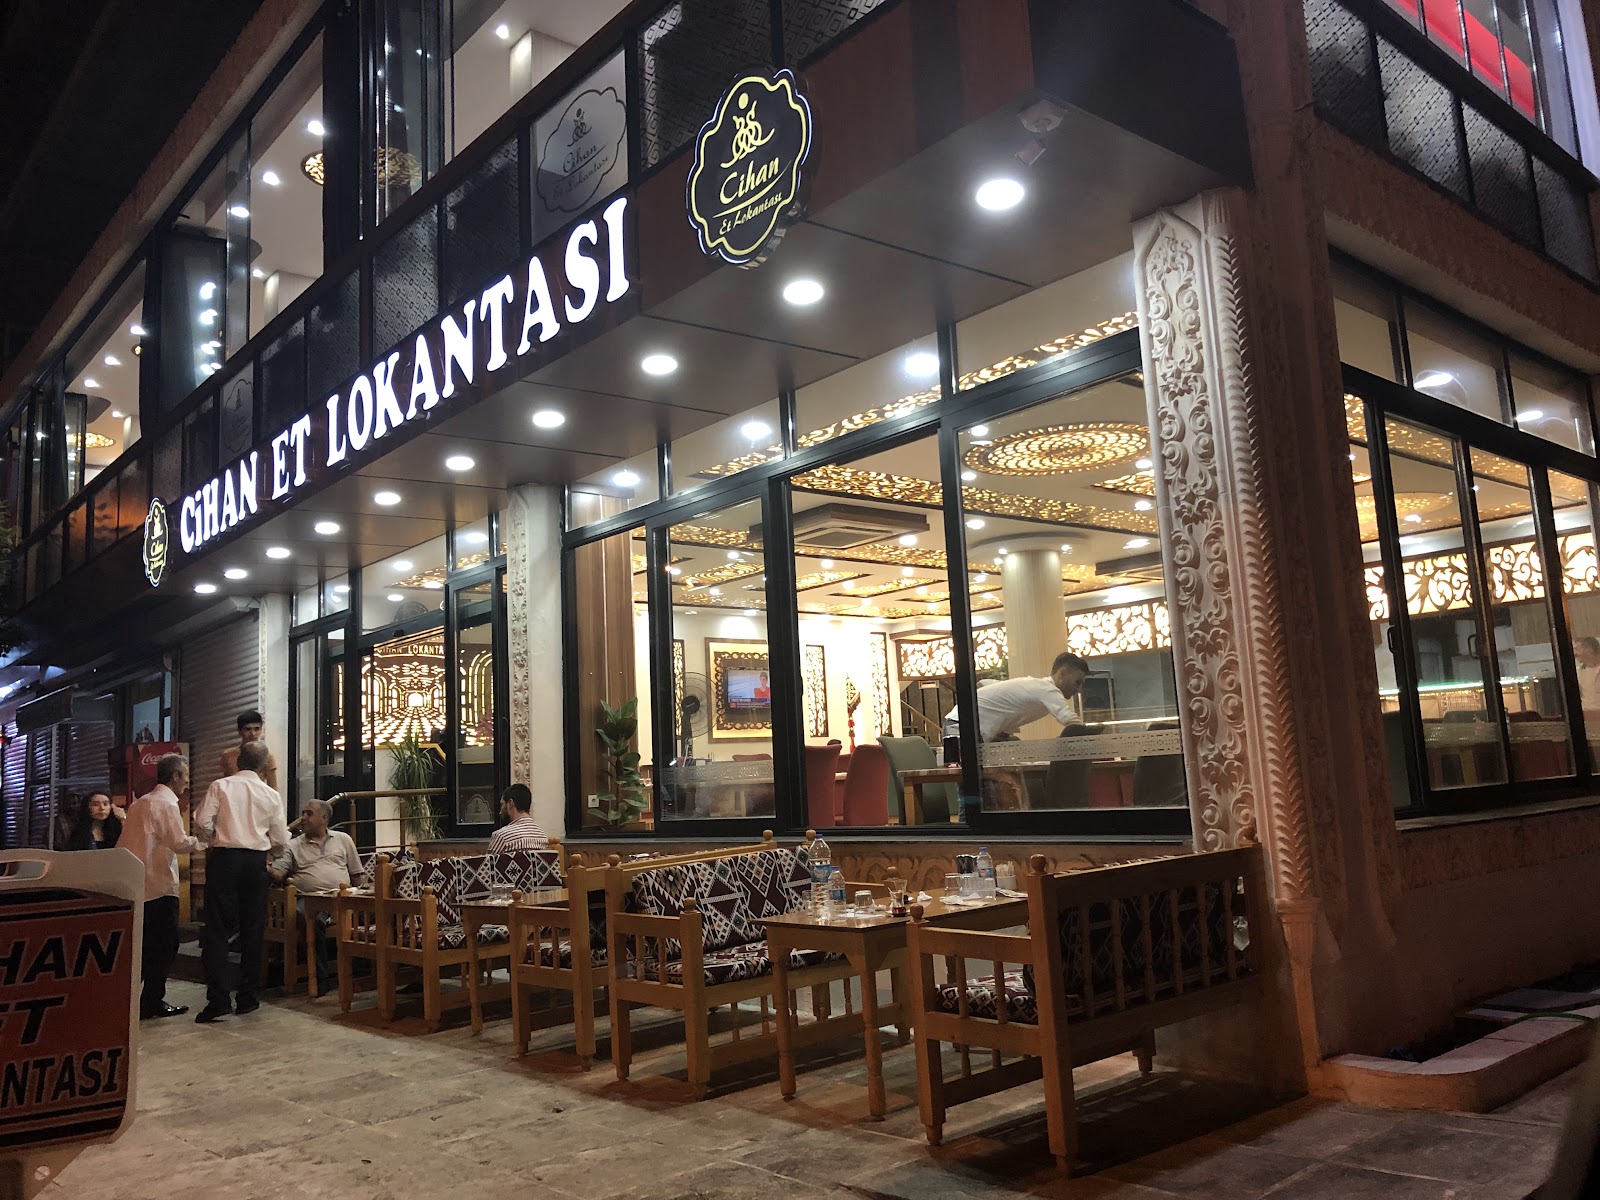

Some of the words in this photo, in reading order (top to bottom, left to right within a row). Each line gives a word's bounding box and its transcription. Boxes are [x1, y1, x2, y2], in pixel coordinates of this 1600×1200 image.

[719, 156, 779, 205] Cihan
[719, 218, 732, 236] Et
[270, 413, 312, 501] ET
[326, 197, 631, 467] LOKANTASI
